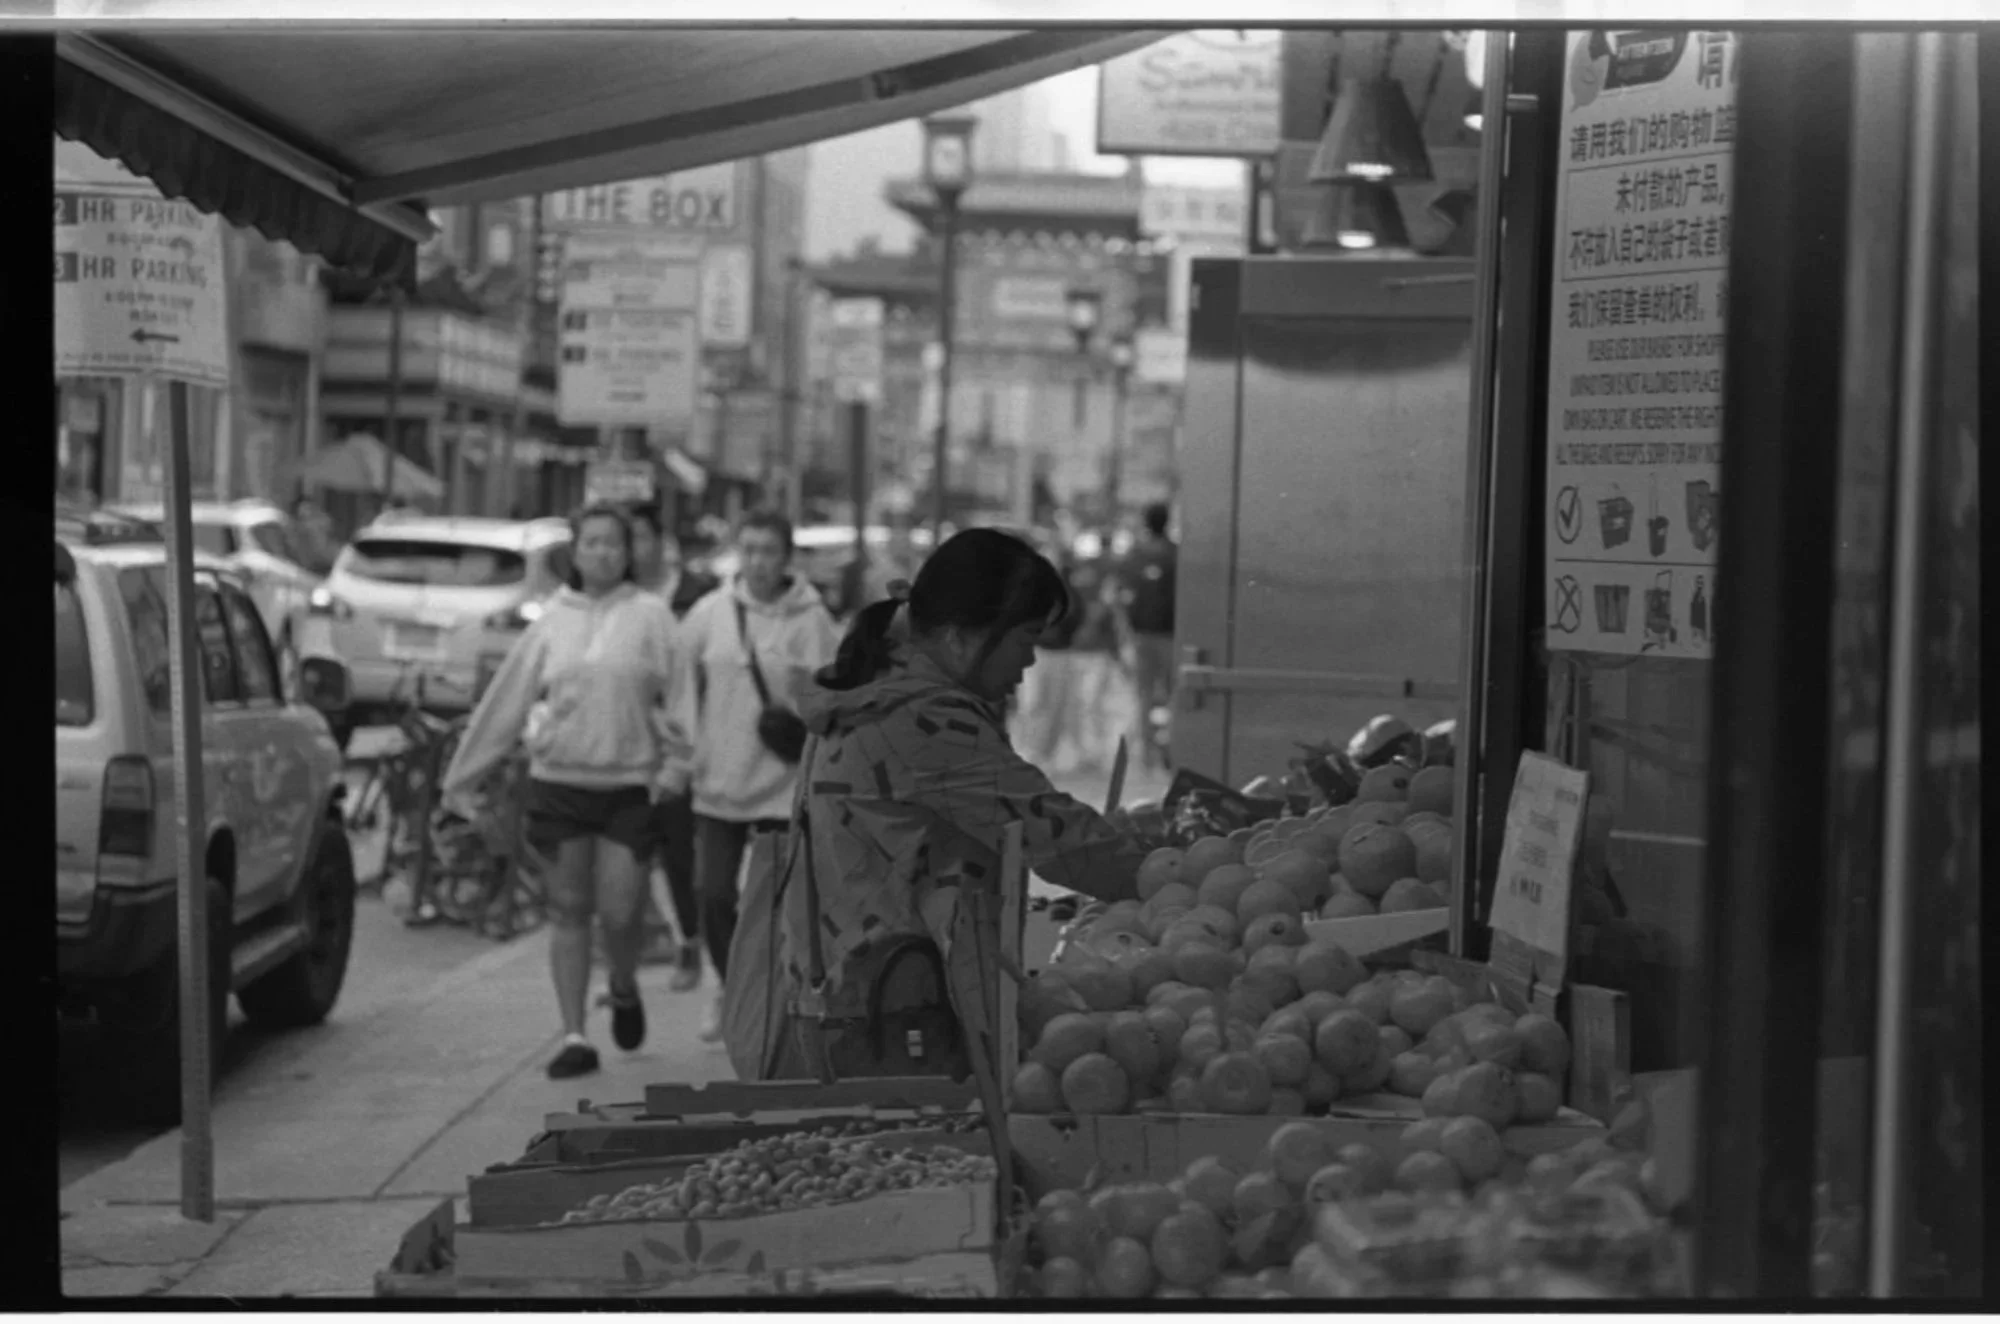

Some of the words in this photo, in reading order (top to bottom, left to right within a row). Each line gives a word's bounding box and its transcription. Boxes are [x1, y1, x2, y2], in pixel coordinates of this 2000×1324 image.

[82, 200, 116, 222] HR
[648, 188, 725, 228] BOX
[82, 257, 117, 279] HR
[1678, 335, 1694, 357] FOR
[1680, 371, 1692, 394] TO
[1642, 407, 1676, 428] RESERVE
[1678, 406, 1693, 428] THE
